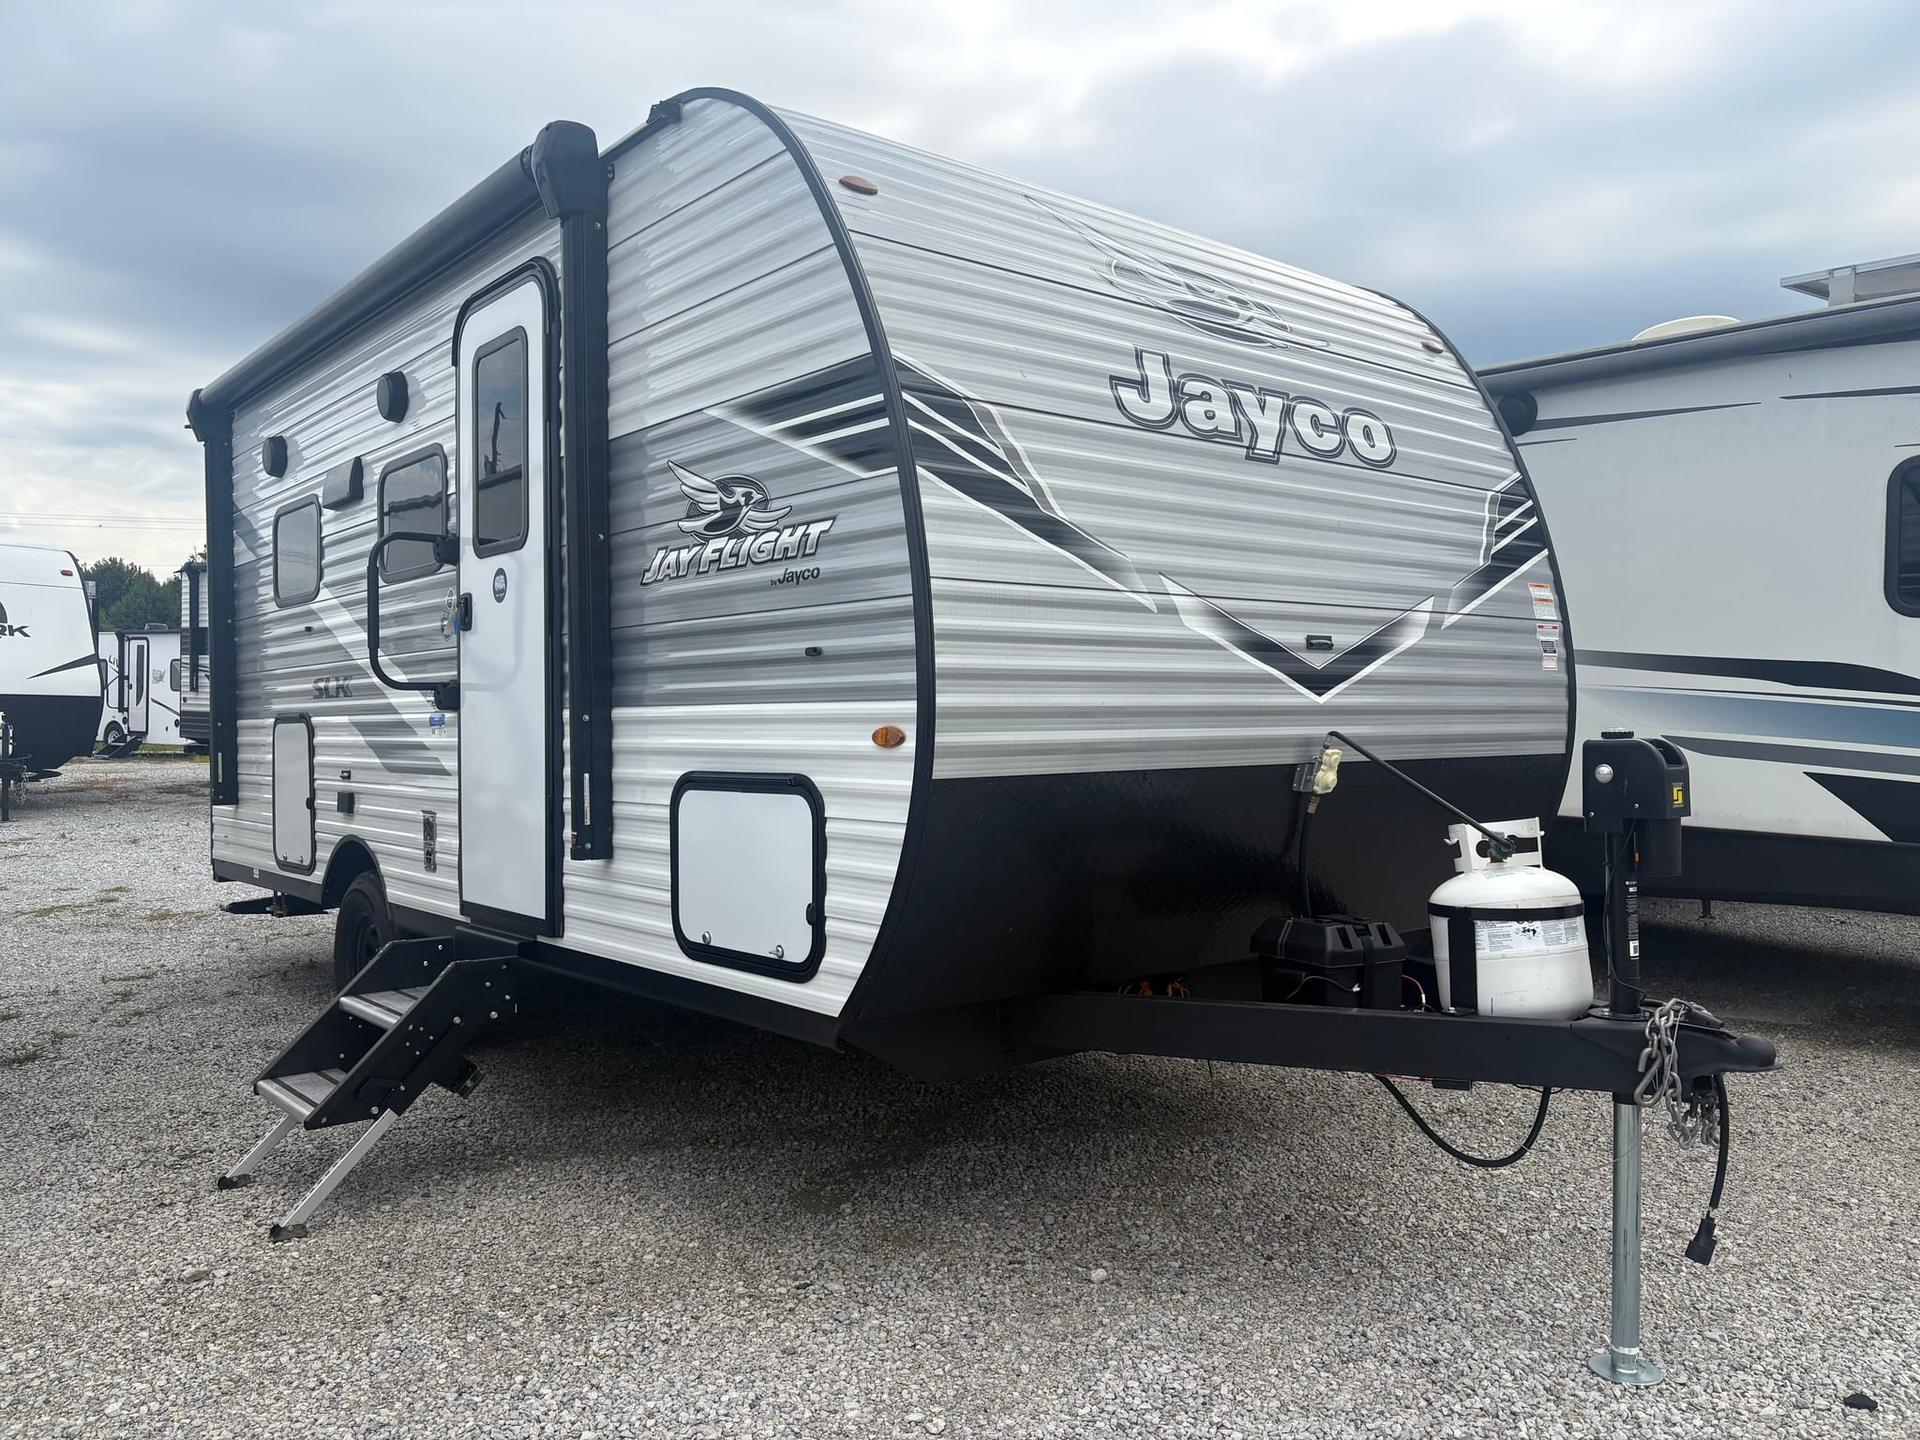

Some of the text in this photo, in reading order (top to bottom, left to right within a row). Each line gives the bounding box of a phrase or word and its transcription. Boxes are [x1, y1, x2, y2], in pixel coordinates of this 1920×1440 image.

[1109, 345, 1397, 468] Jayco
[777, 567, 821, 586] Jayco
[313, 676, 353, 699] SLK
